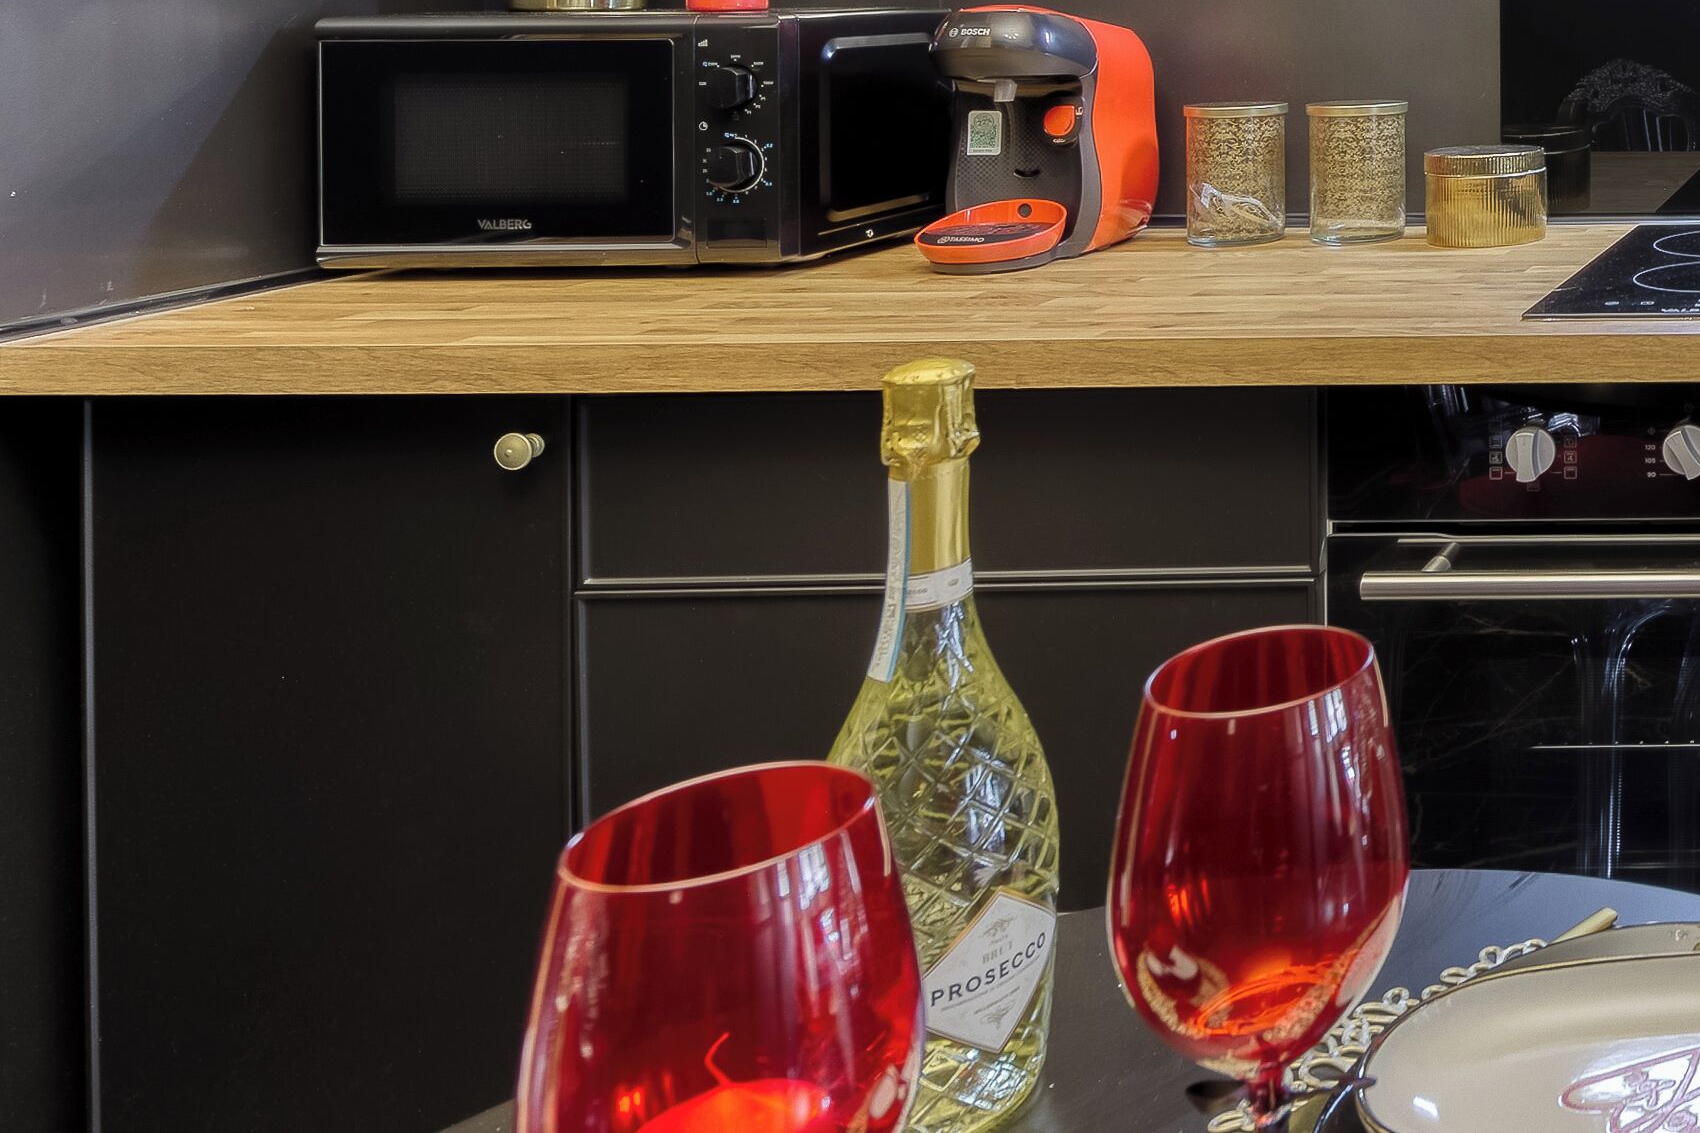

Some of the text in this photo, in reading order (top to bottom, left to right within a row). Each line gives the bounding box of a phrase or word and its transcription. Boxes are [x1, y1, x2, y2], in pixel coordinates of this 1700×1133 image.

[960, 28, 991, 36] BOSCH
[477, 218, 533, 230] VALBERG
[930, 932, 1047, 1007] PROSECCO
